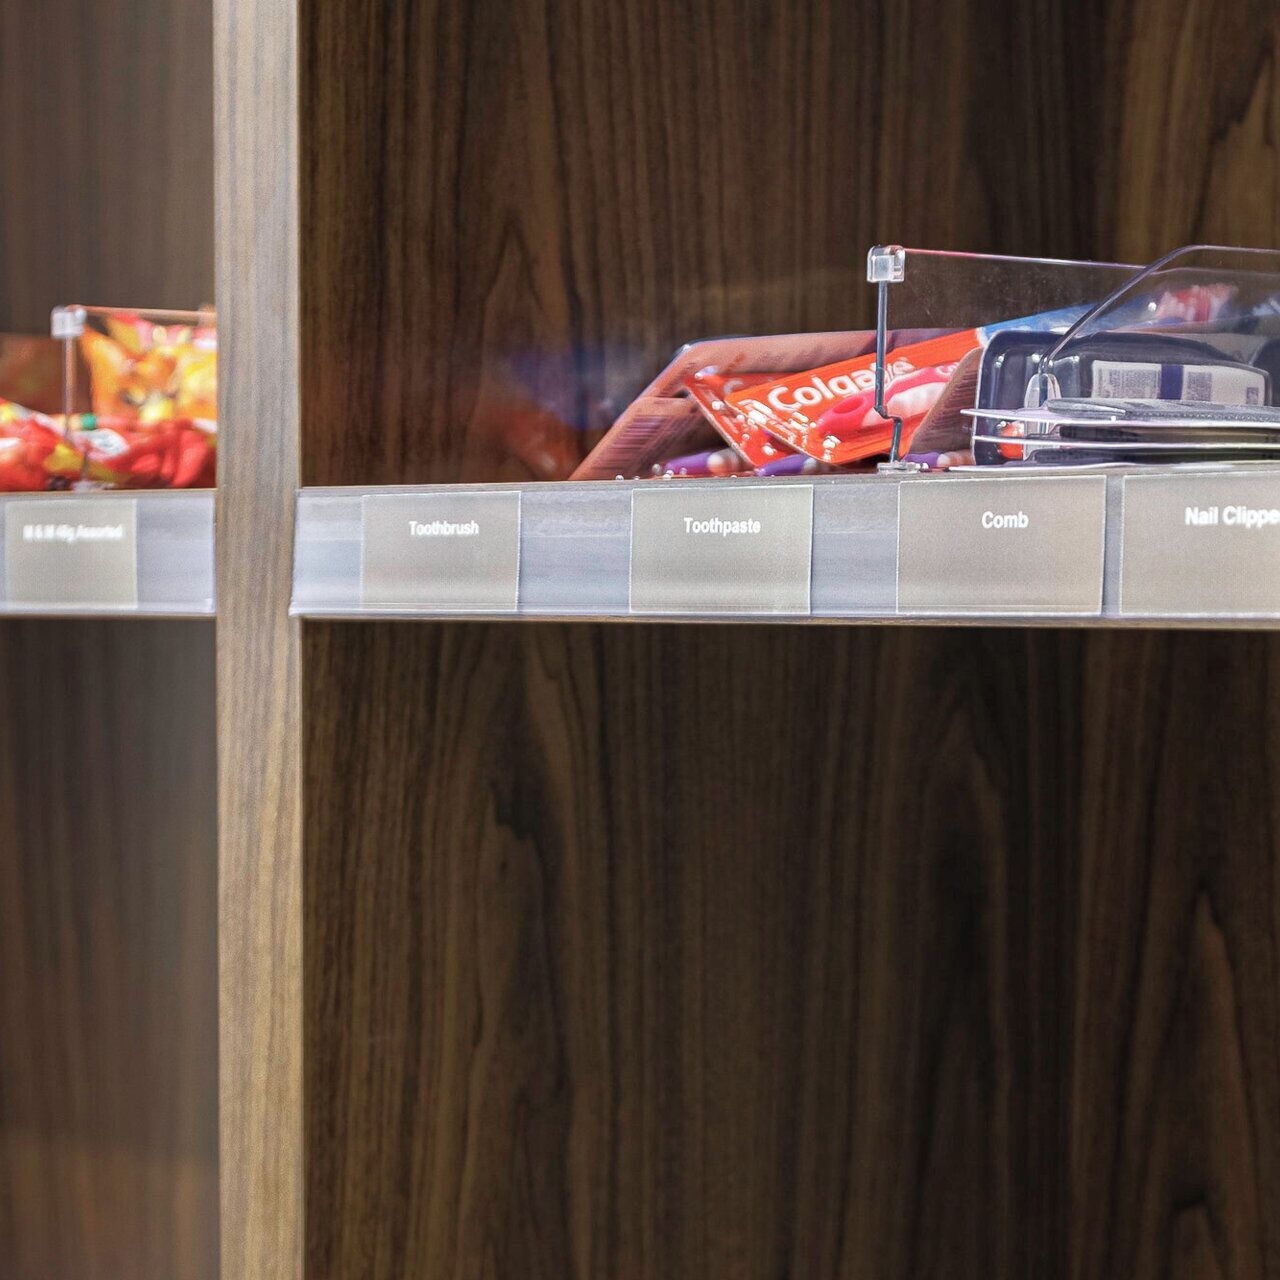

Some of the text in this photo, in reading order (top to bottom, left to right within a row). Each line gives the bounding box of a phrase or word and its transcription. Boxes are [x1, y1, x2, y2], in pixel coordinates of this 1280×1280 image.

[981, 511, 1030, 530] Comb
[1185, 506, 1219, 527] Nail
[408, 520, 480, 536] Toothbrush
[683, 517, 762, 537] Toothpaste
